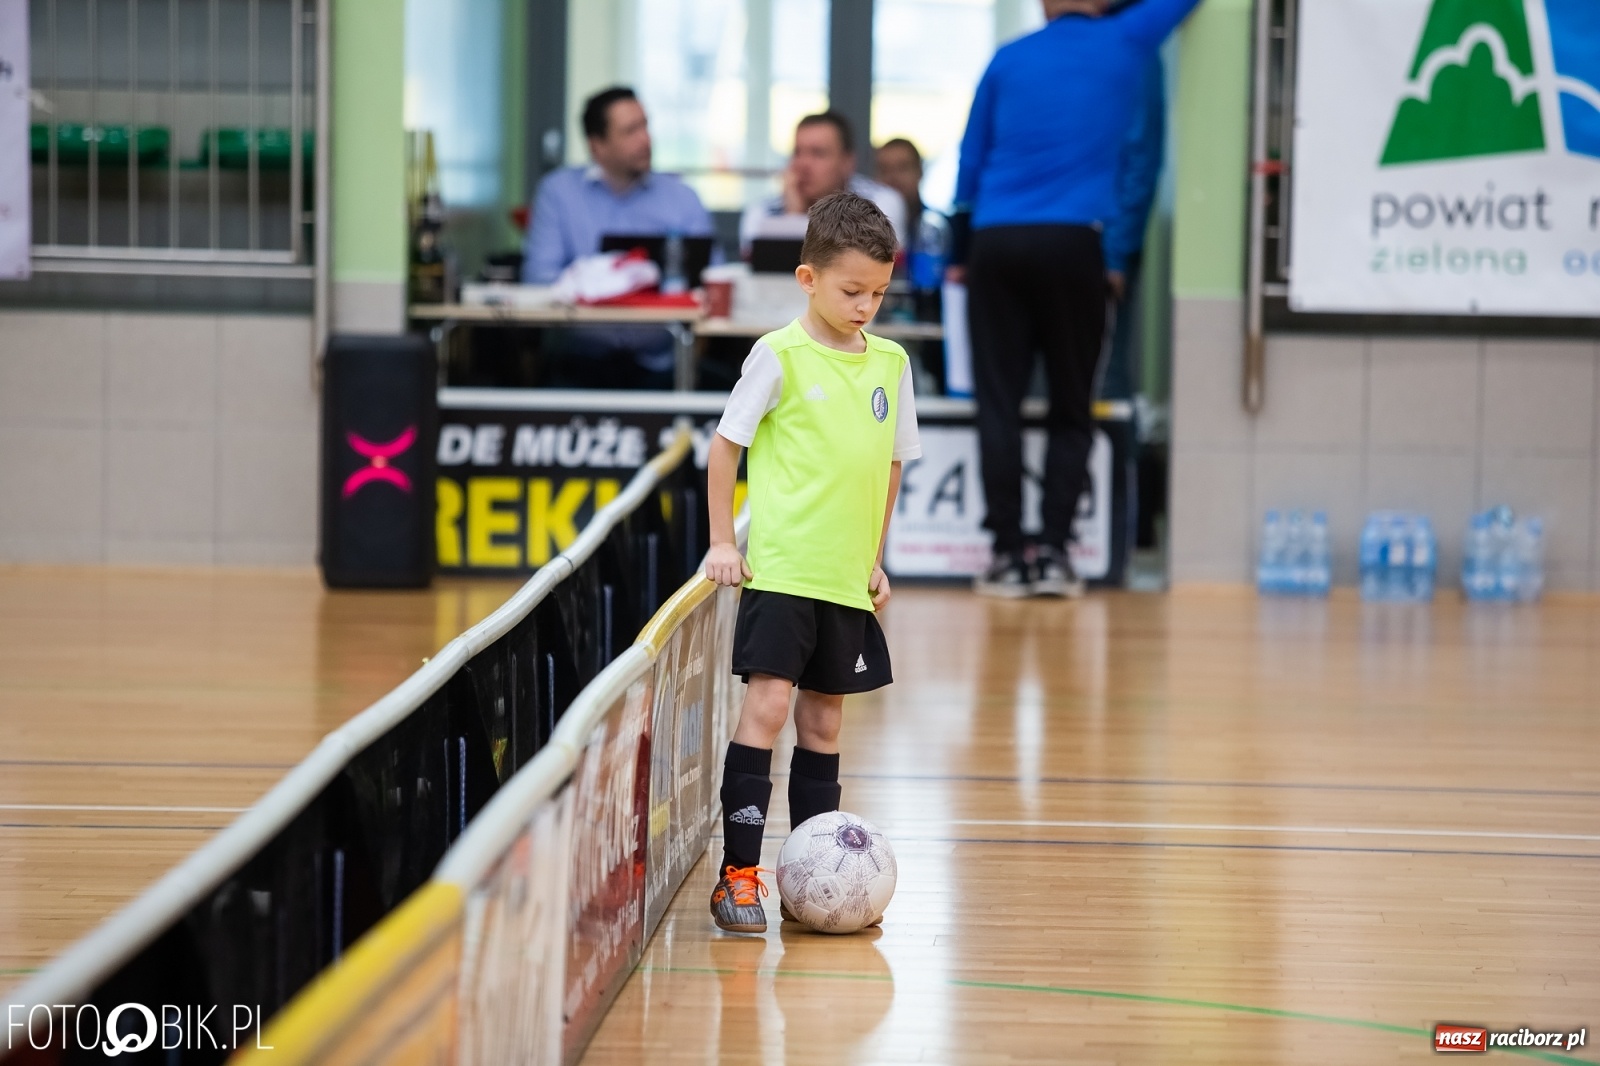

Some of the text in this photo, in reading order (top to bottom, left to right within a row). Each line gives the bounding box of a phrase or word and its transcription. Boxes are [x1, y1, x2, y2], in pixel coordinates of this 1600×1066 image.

[1370, 180, 1552, 239] powiat
[1371, 240, 1528, 275] zielona
[729, 813, 765, 826] adidas
